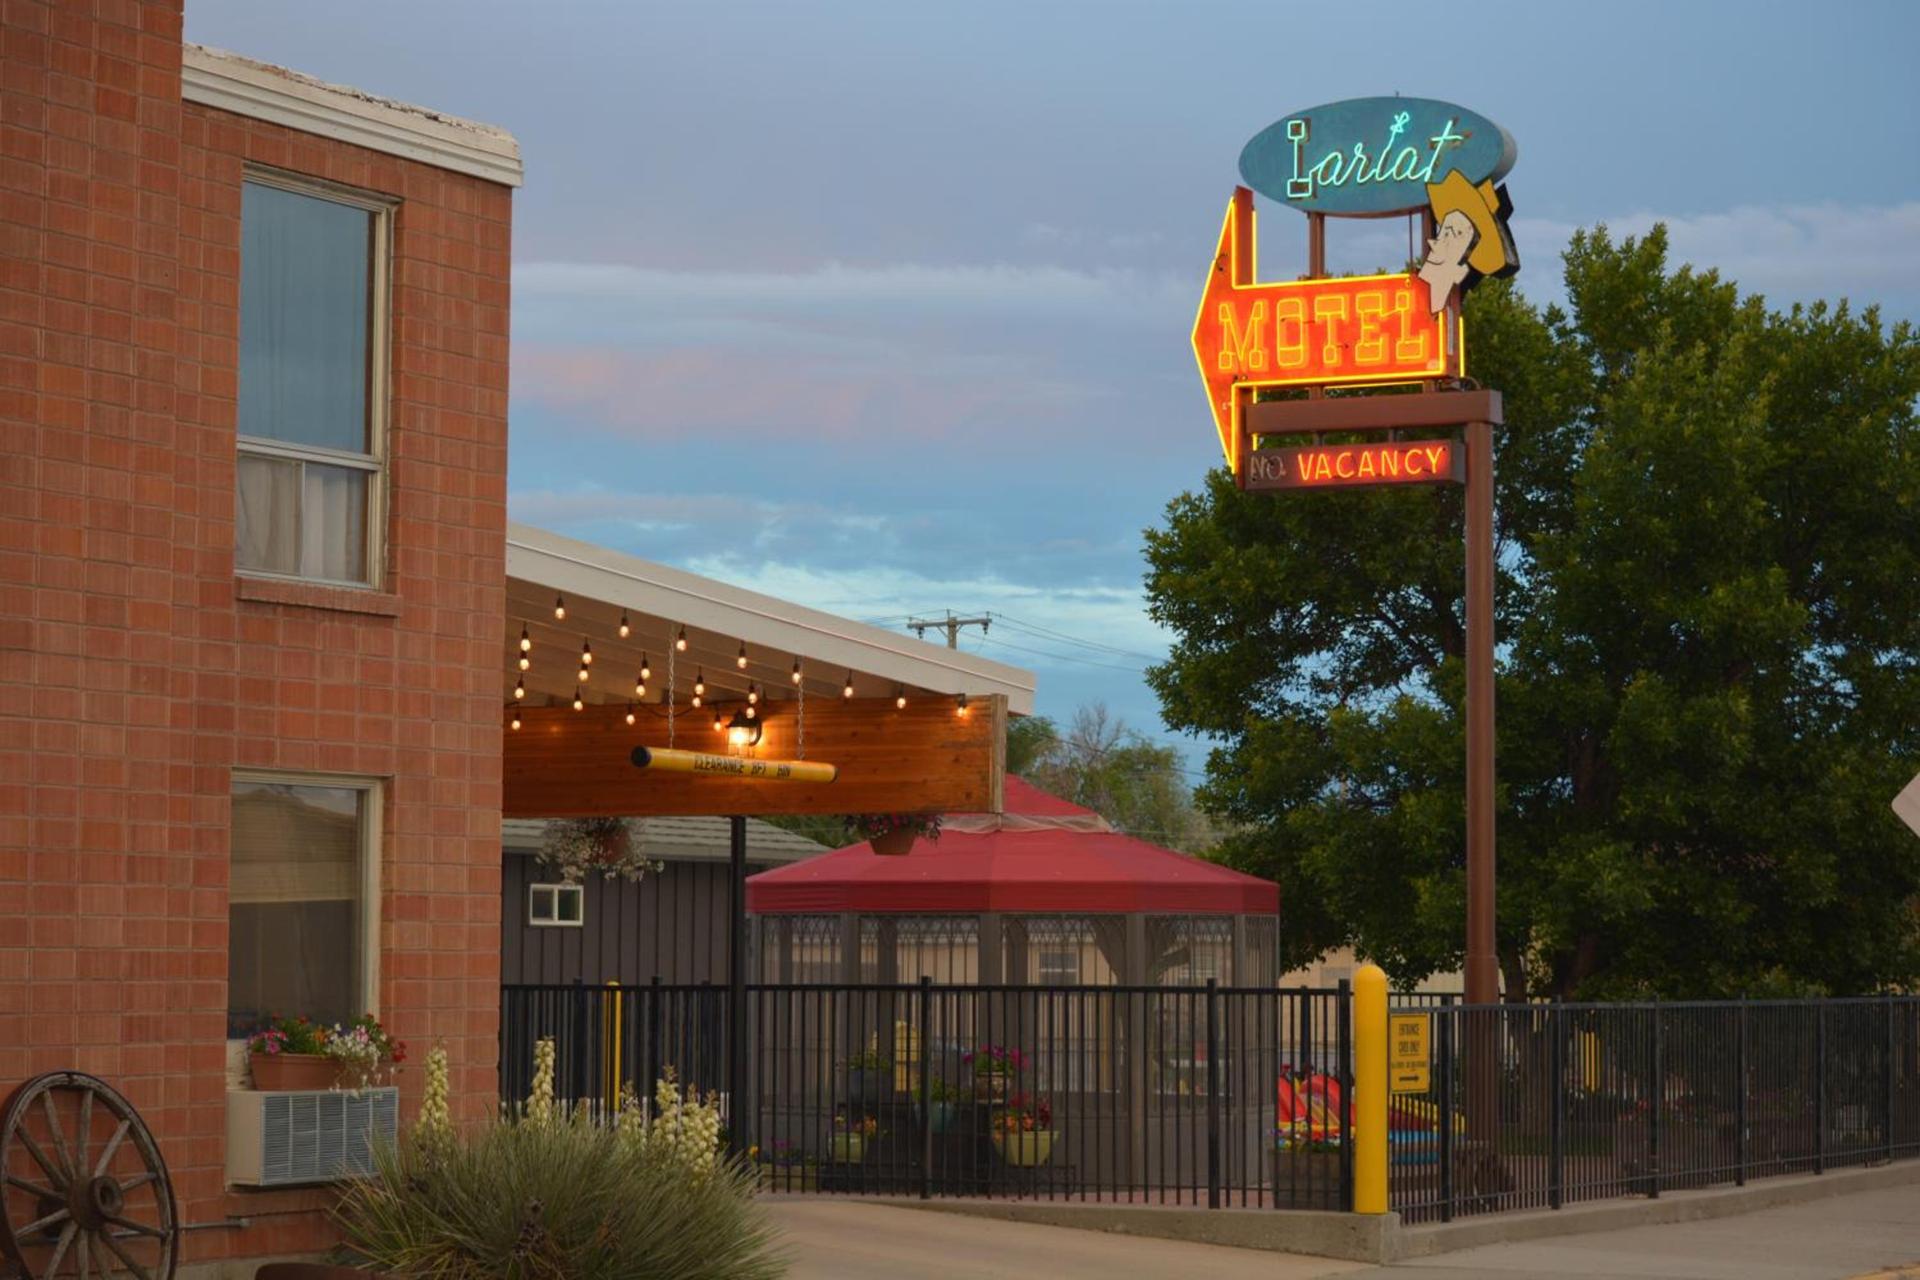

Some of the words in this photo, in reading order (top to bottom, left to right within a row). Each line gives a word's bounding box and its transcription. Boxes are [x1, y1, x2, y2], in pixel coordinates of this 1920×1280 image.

[1286, 111, 1465, 198] Lariat
[1217, 290, 1427, 371] MOTEL
[1250, 455, 1284, 481] NO
[1297, 446, 1443, 481] VACANCY
[694, 755, 744, 775] CLEARANCE
